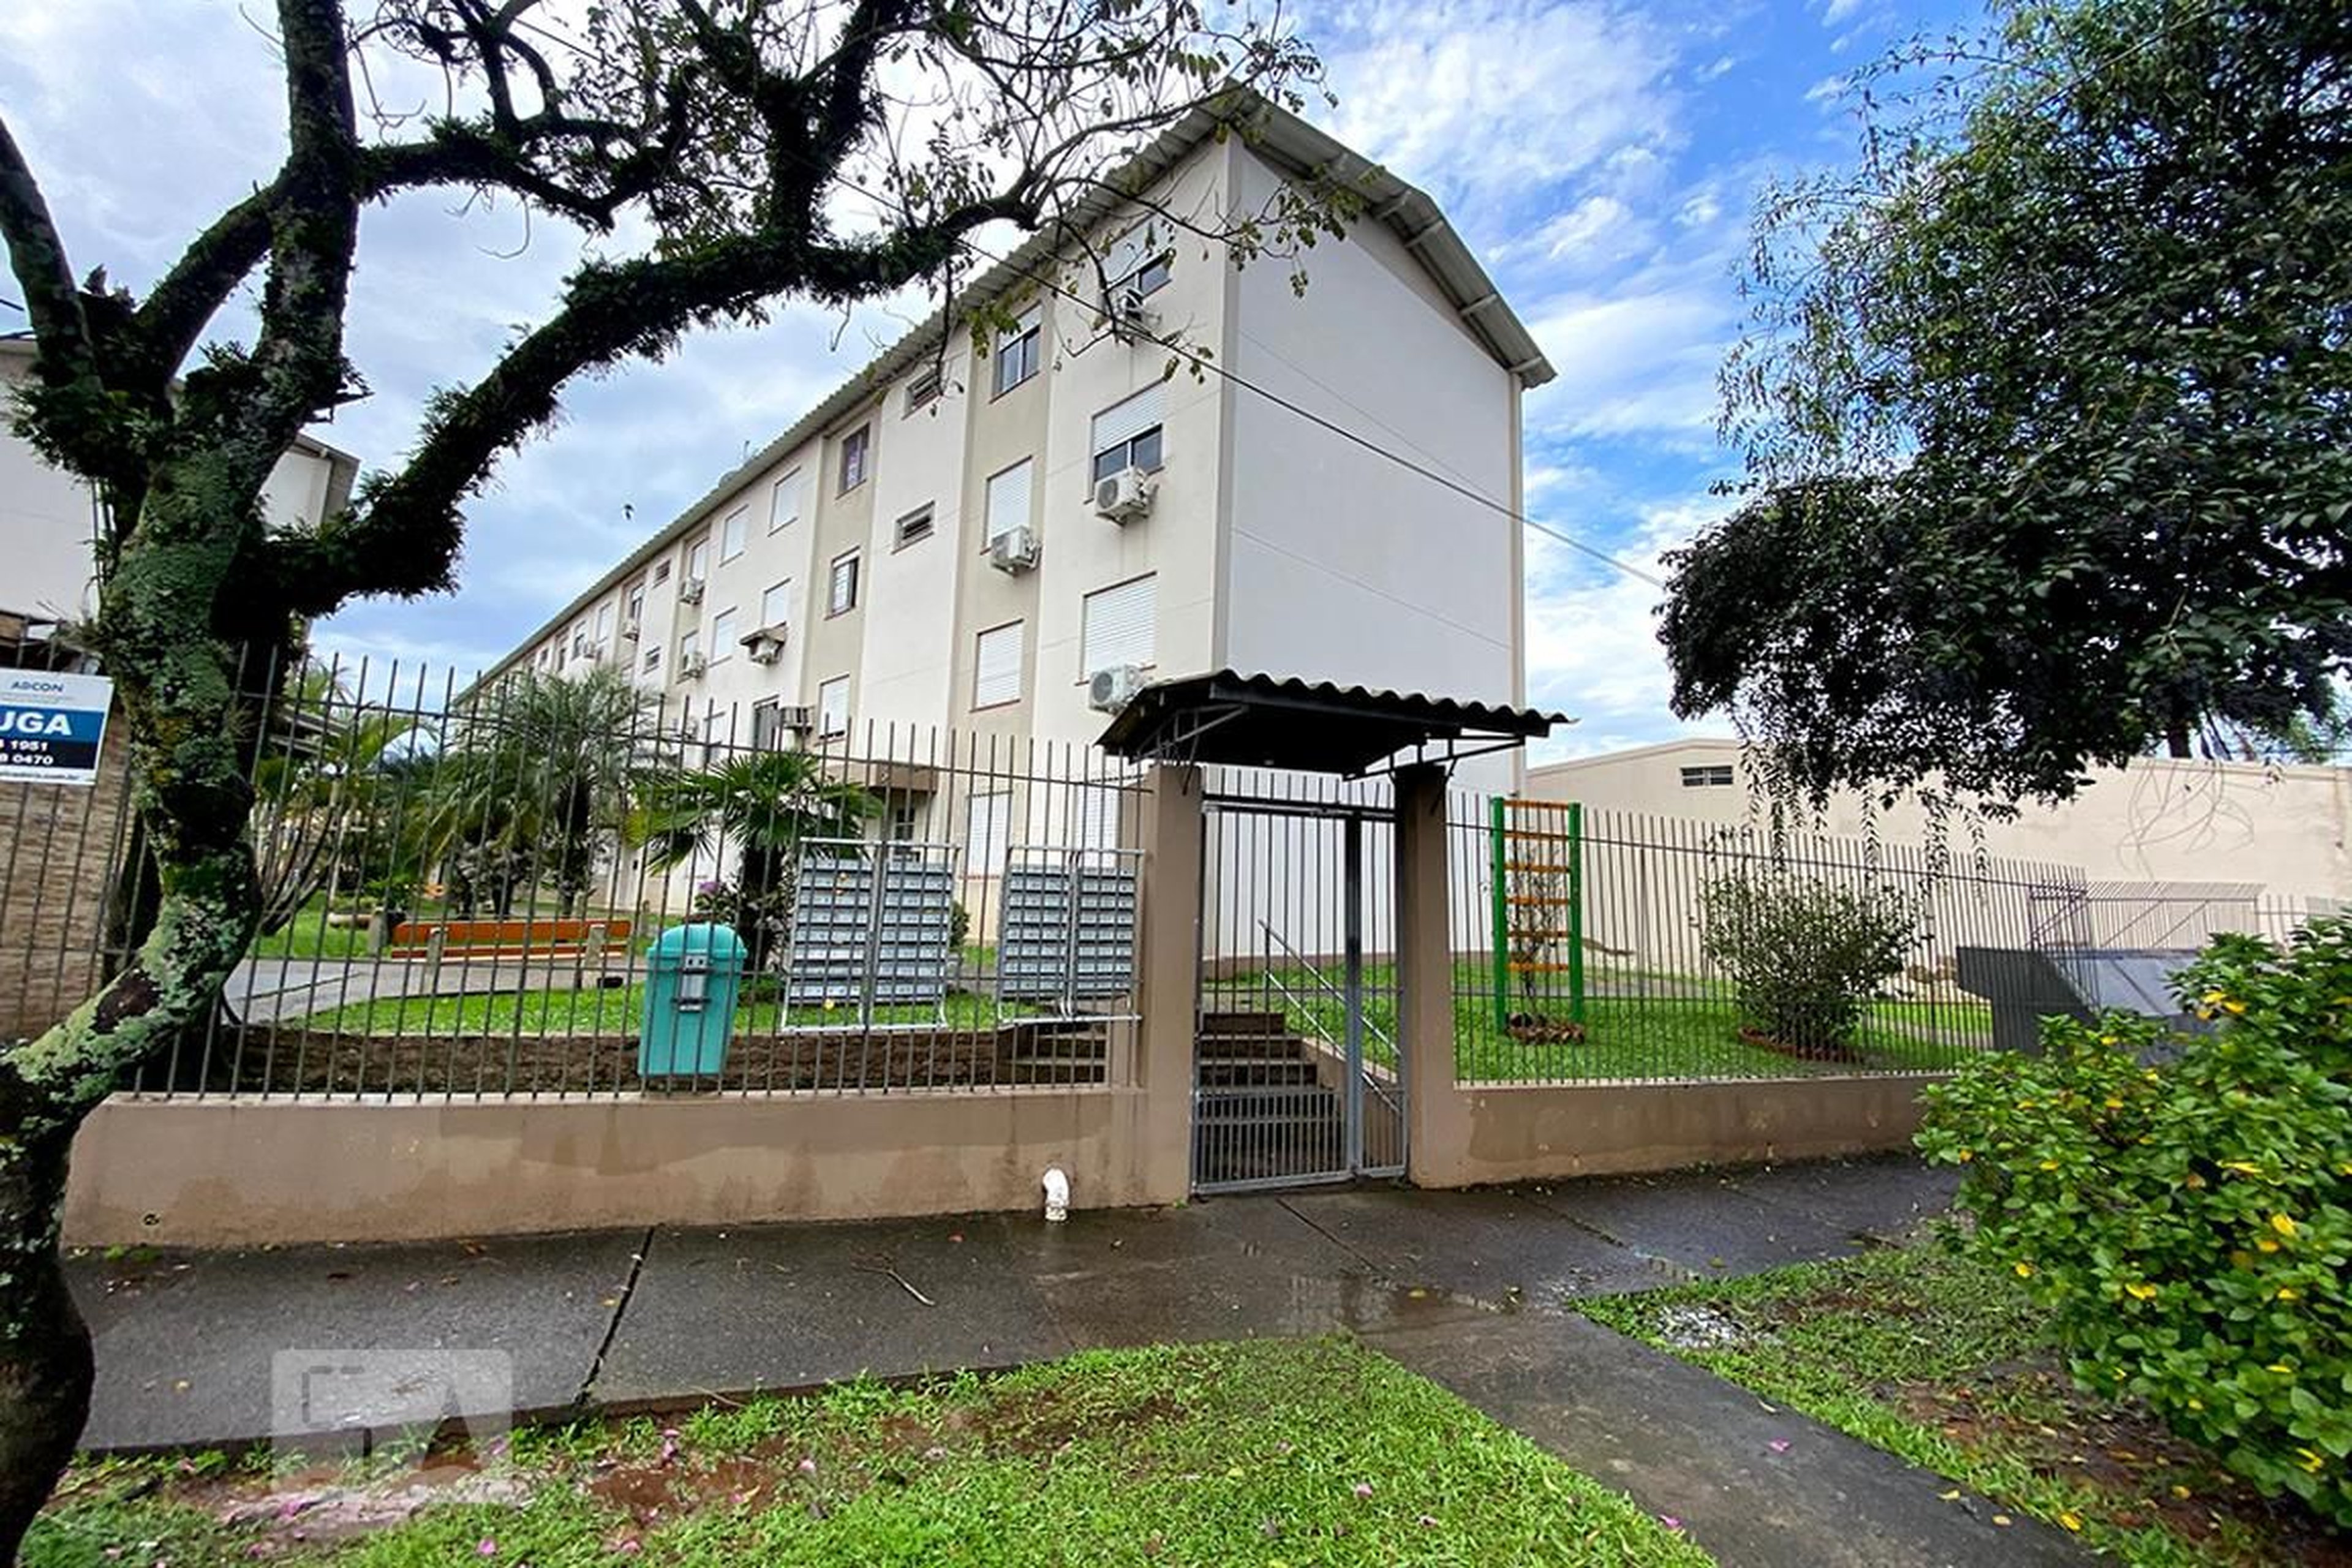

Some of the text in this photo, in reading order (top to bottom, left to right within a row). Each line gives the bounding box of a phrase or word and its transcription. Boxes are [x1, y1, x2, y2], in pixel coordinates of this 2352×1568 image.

[11, 681, 64, 692] ADCON
[11, 740, 48, 752] 1951
[12, 753, 54, 765] 0470
